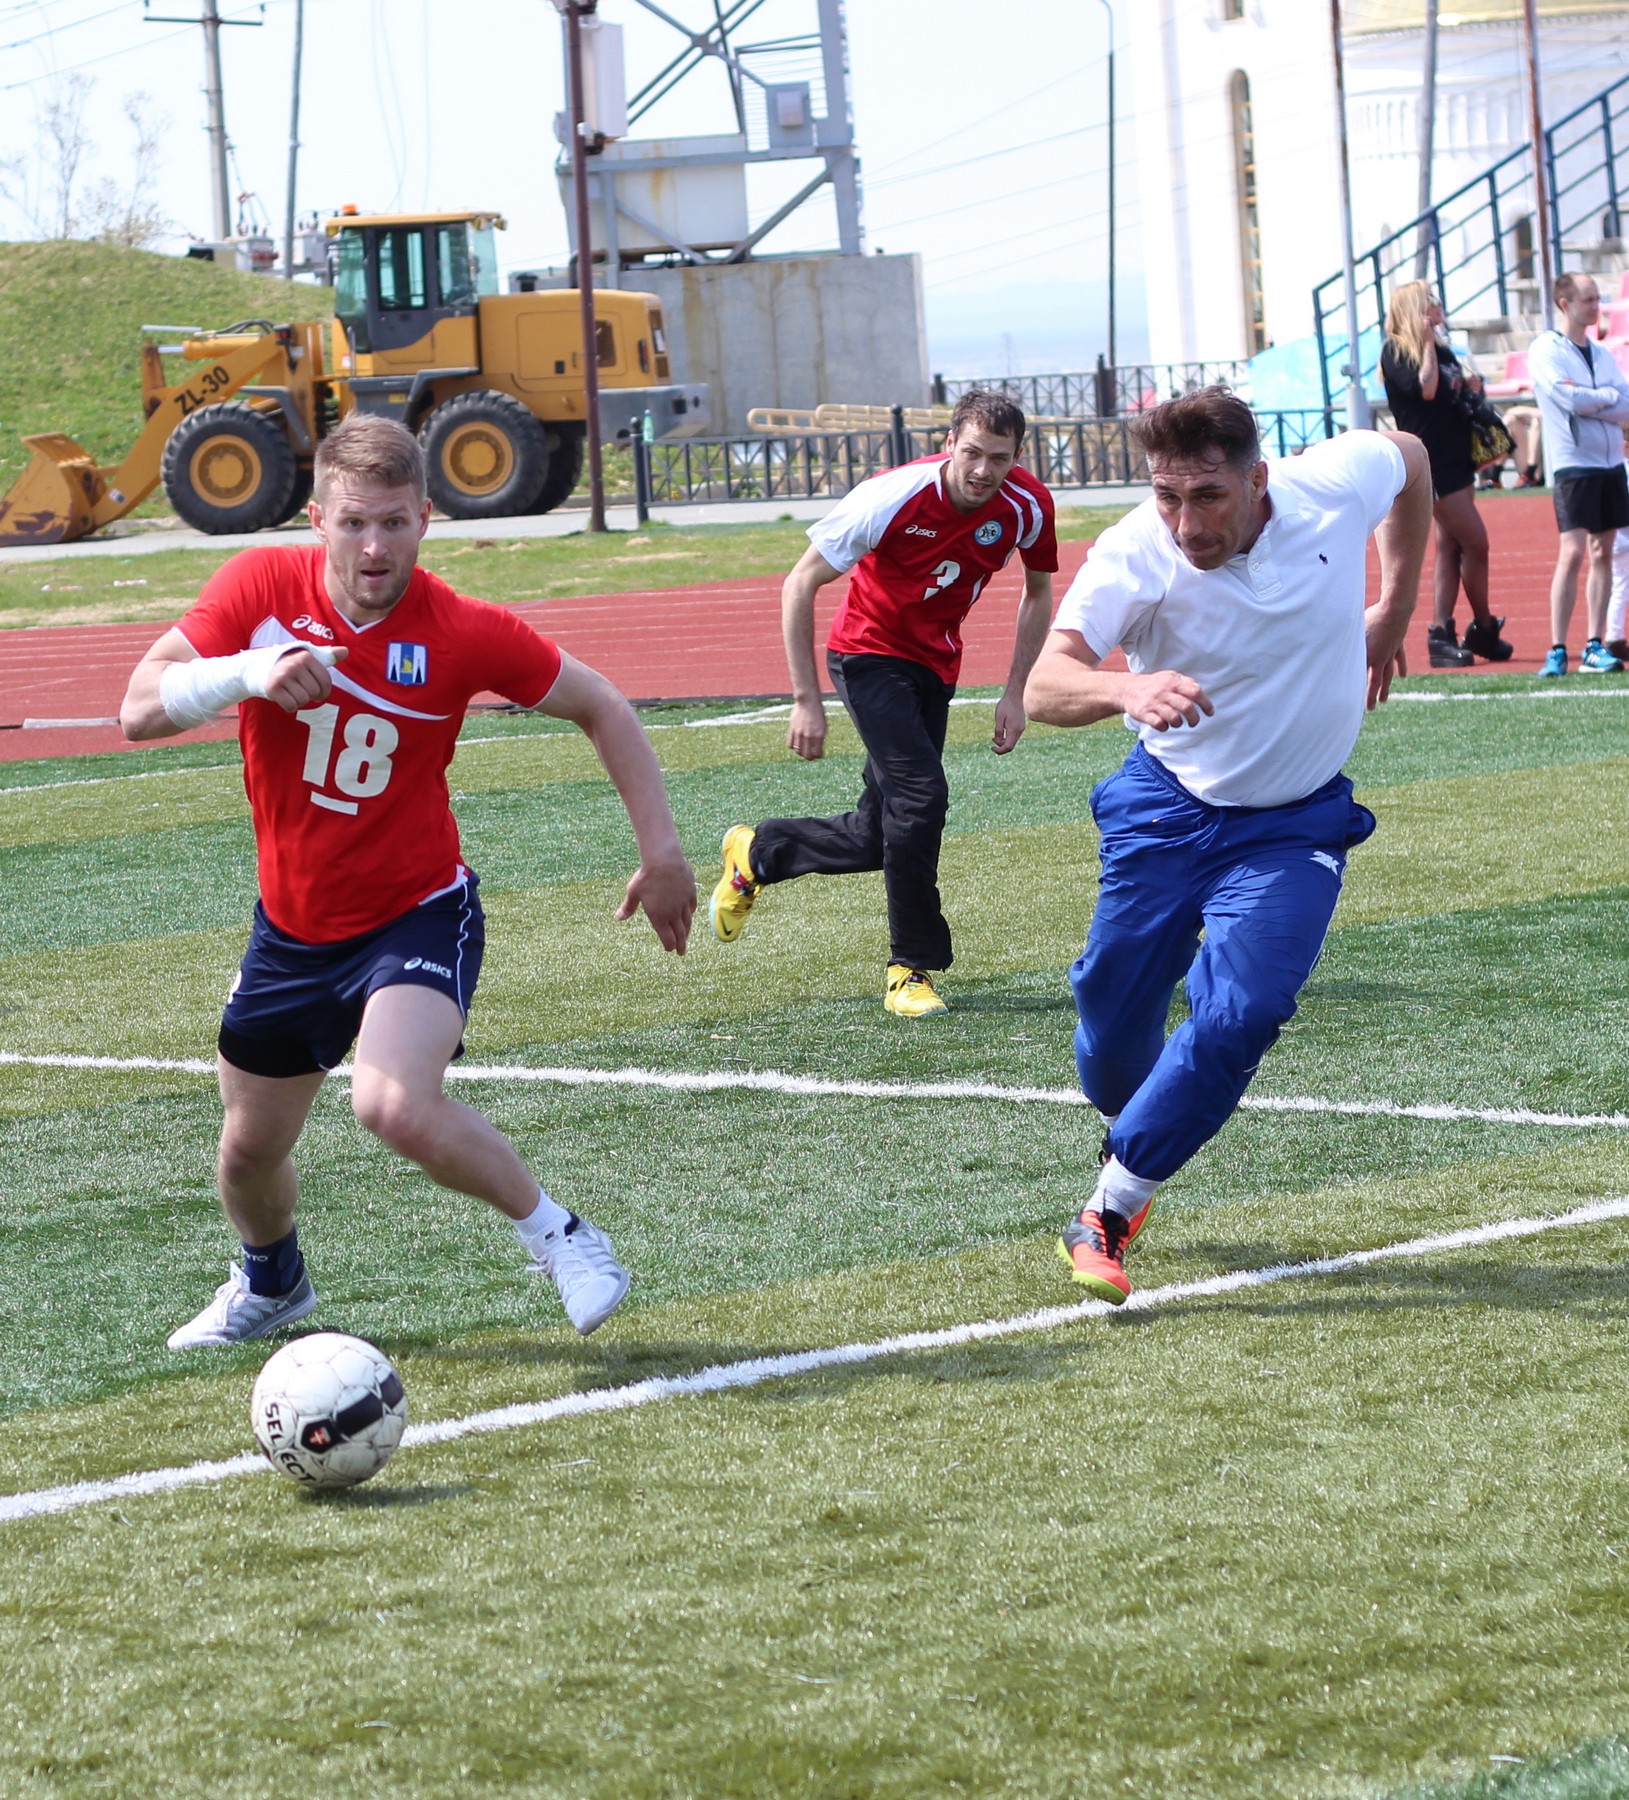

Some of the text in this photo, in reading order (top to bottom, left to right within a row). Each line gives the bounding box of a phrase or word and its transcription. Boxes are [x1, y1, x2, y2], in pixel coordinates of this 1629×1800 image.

[174, 366, 230, 415] ZL-30
[923, 560, 961, 601] 3
[295, 702, 400, 799] 18
[264, 1402, 317, 1483] SELECT
